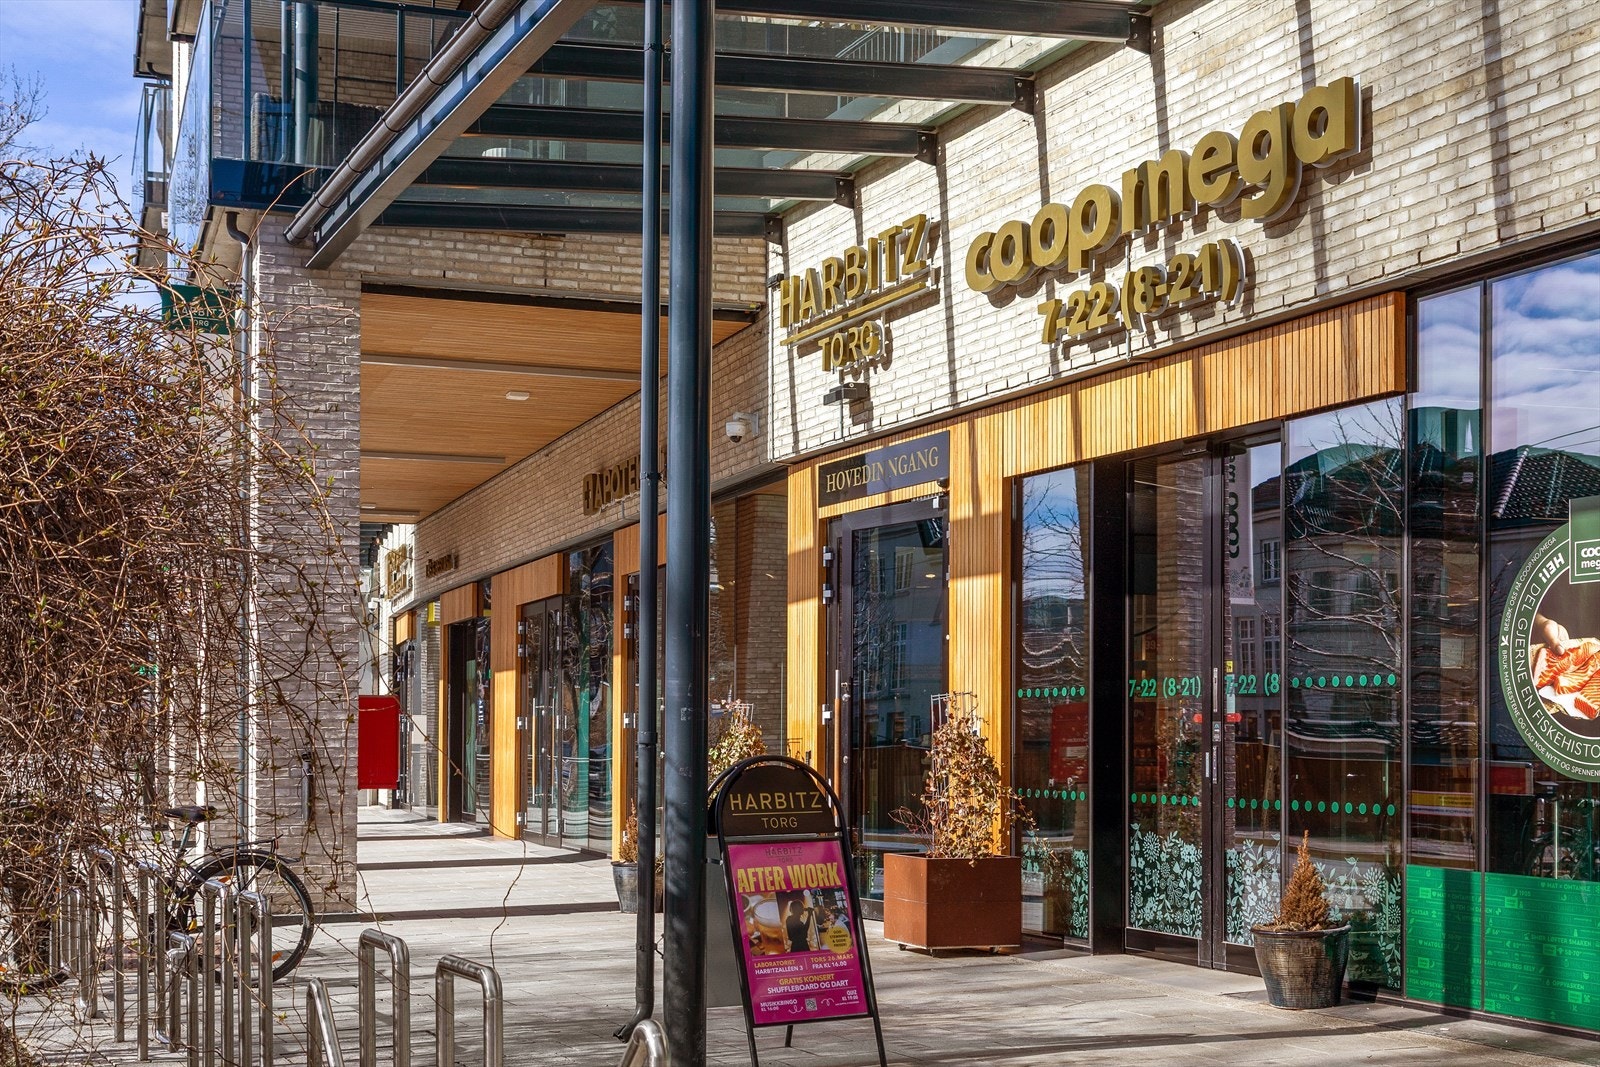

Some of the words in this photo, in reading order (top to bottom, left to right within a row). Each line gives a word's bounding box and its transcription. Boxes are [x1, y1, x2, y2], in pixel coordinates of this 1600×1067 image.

[965, 184, 1121, 292] coop
[1121, 76, 1355, 236] mega
[780, 214, 927, 328] HARBITZ
[1038, 281, 1118, 344] 7-22
[1119, 238, 1242, 330] (8-21)
[818, 320, 882, 372] TORG
[594, 454, 641, 509] APOTE
[1509, 592, 1518, 606] OSS
[1515, 581, 1523, 592] PÅ
[1522, 583, 1541, 611] DEL
[1514, 618, 1529, 684] GJERNE
[1128, 678, 1157, 697] 7-22
[1162, 675, 1202, 699] (8-21)
[1225, 674, 1257, 696] 7-22
[1520, 686, 1536, 709] EN
[1503, 671, 1521, 718] MATRESTENE
[1518, 717, 1527, 730] OG
[1524, 729, 1536, 743] LAG
[1533, 741, 1547, 755] NOE
[1545, 751, 1561, 765] NYTT
[1560, 761, 1571, 770] OG
[1571, 765, 1600, 777] SPENNEN
[729, 791, 823, 811] HARBITZ
[761, 817, 798, 829] TORG
[737, 865, 787, 893] AFTER
[787, 862, 842, 889] WORK
[754, 959, 796, 969] LABORATORIET
[767, 982, 819, 994] SHUFFLEBOARD
[819, 981, 831, 989] OG
[831, 979, 849, 987] DART
[778, 976, 804, 986] GRATIS
[804, 973, 835, 983] KONSERT
